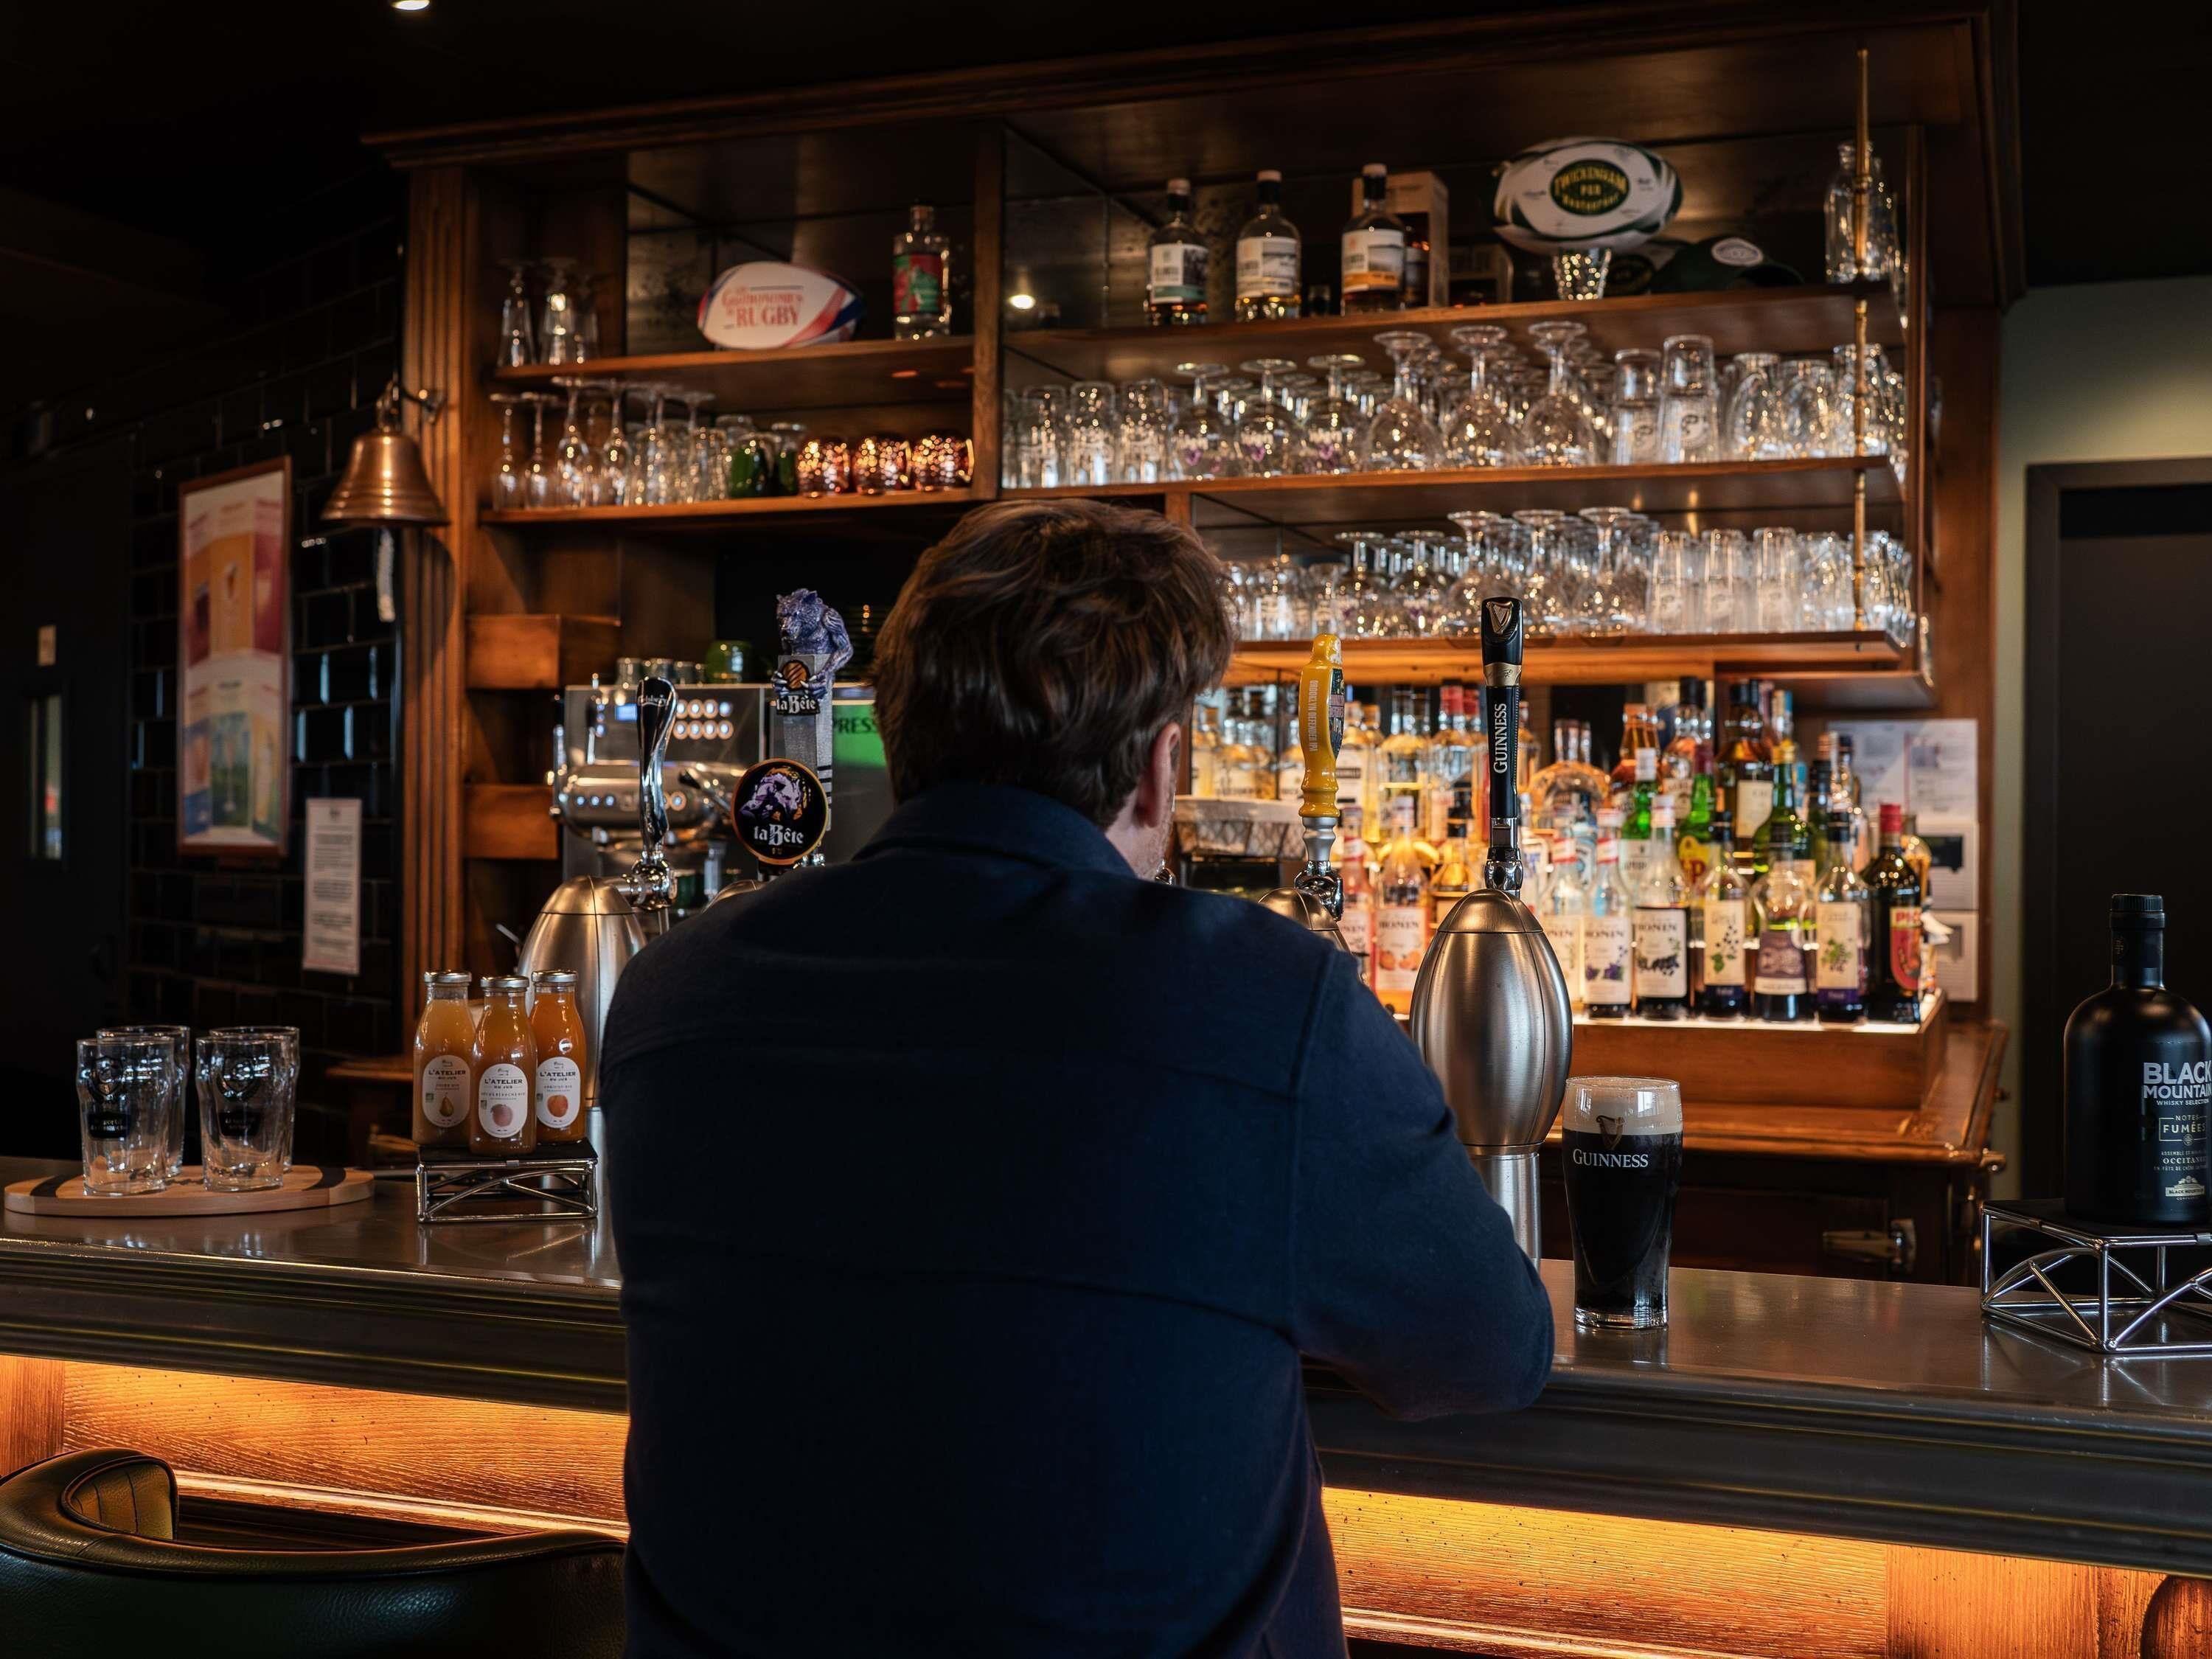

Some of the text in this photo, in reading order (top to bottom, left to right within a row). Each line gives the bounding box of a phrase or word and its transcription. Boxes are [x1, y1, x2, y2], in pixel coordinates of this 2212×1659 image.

[737, 305, 799, 326] RUGBY
[1493, 702, 1508, 774] GUINNESS
[2143, 1060, 2212, 1084] BLACK
[1572, 1148, 1649, 1168] GUINNESS
